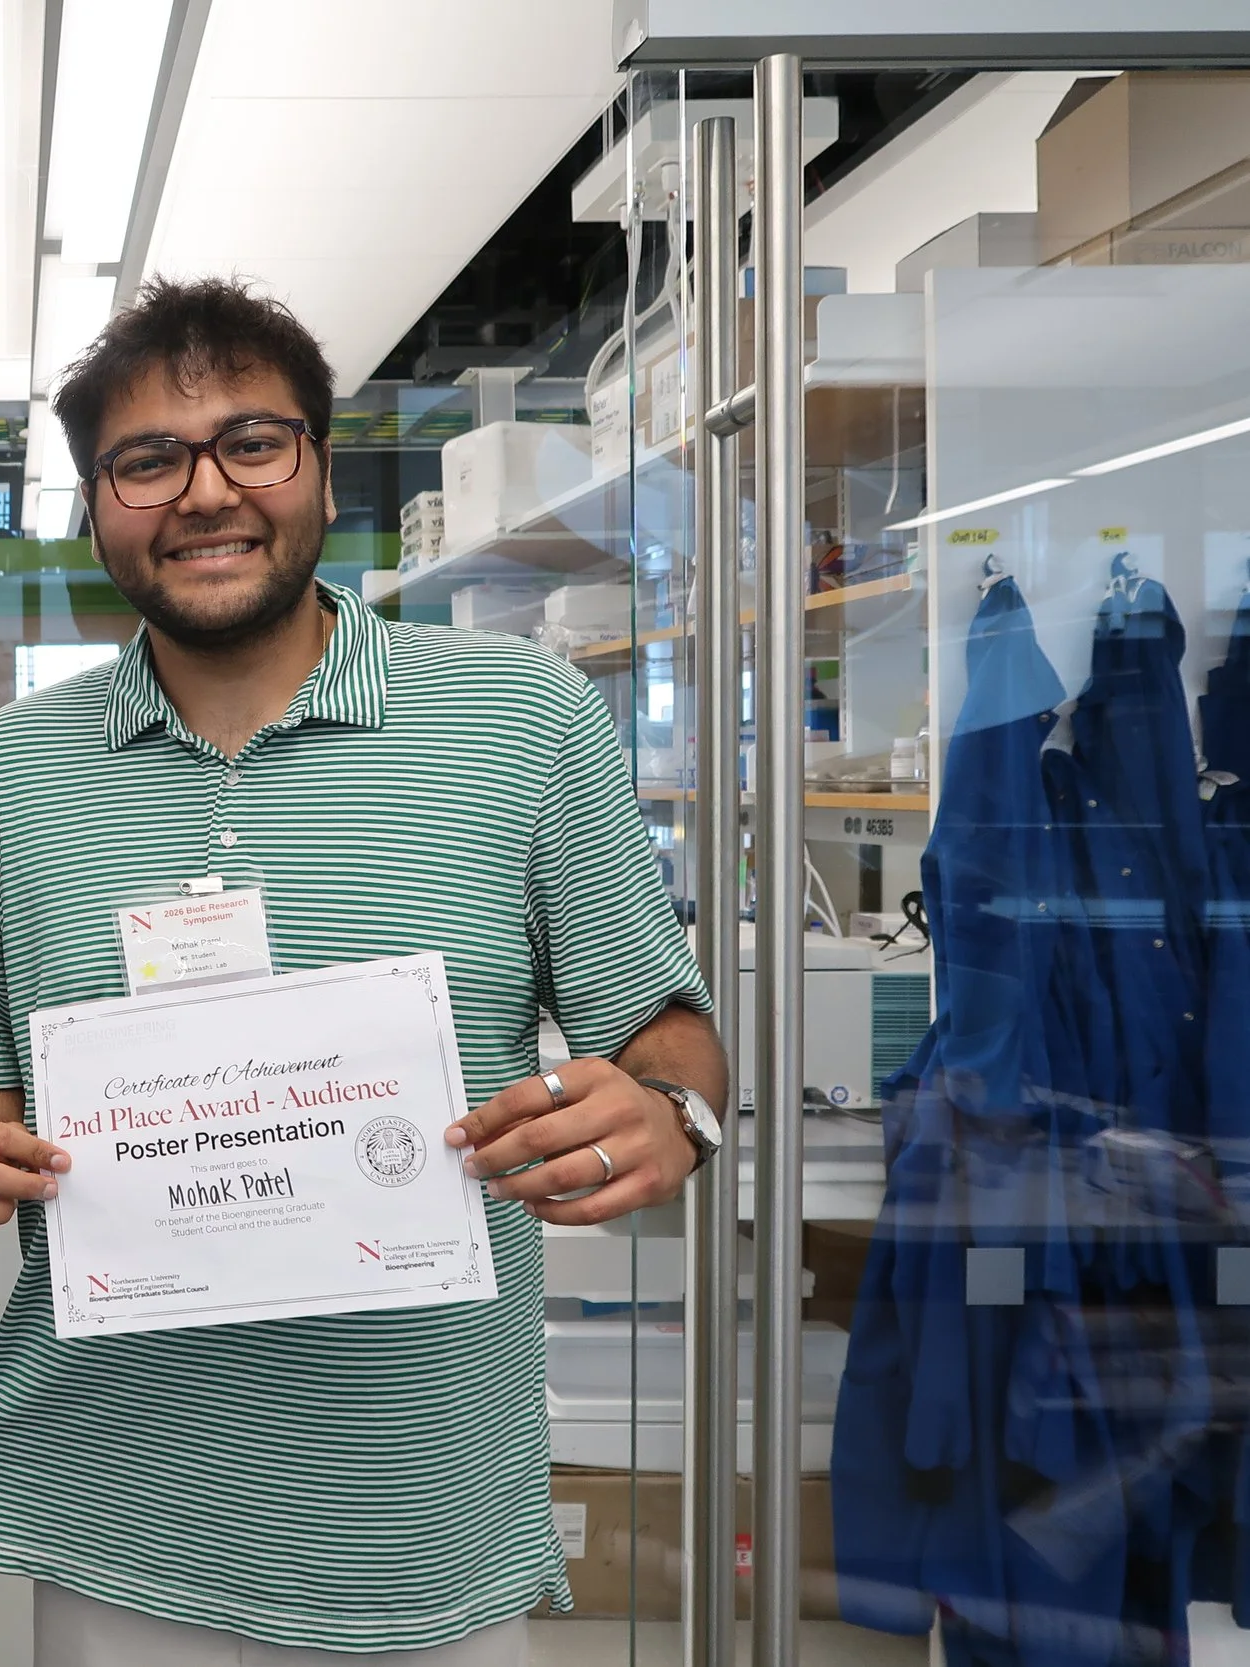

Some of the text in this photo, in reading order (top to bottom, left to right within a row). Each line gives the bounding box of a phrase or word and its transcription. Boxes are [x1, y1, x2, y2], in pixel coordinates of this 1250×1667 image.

[1168, 242, 1242, 258] FALCON
[164, 898, 249, 918] 2026 BioE Research
[183, 912, 234, 926] Symposium
[171, 940, 199, 951] Mohak
[191, 952, 216, 960] Student
[104, 1054, 344, 1100] Certificate of Achievement
[59, 1112, 103, 1139] 2nd
[110, 1105, 172, 1131] Place
[179, 1091, 260, 1123] Award
[281, 1078, 400, 1110] Audience
[360, 1119, 417, 1143] NORTHEASTERN
[115, 1119, 345, 1161] Poster Presentation
[190, 1158, 268, 1174] This award goes to
[240, 1168, 294, 1199] Patel
[370, 1168, 417, 1184] UNIVERSITY
[154, 1201, 326, 1228] On behalf of the Bioengineering Graduate
[171, 1215, 312, 1238] Student Council and the audience
[355, 1239, 381, 1263] N
[382, 1239, 460, 1252] Northeastern University
[384, 1253, 407, 1261] College
[416, 1248, 454, 1259] Engineering
[385, 1261, 435, 1271] Bioengineering
[86, 1273, 110, 1295] N
[111, 1274, 180, 1286] Northeastern University
[112, 1285, 133, 1293] College
[140, 1282, 174, 1291] Engineering
[89, 1285, 209, 1302] Bioengineering Graduate Student Council
